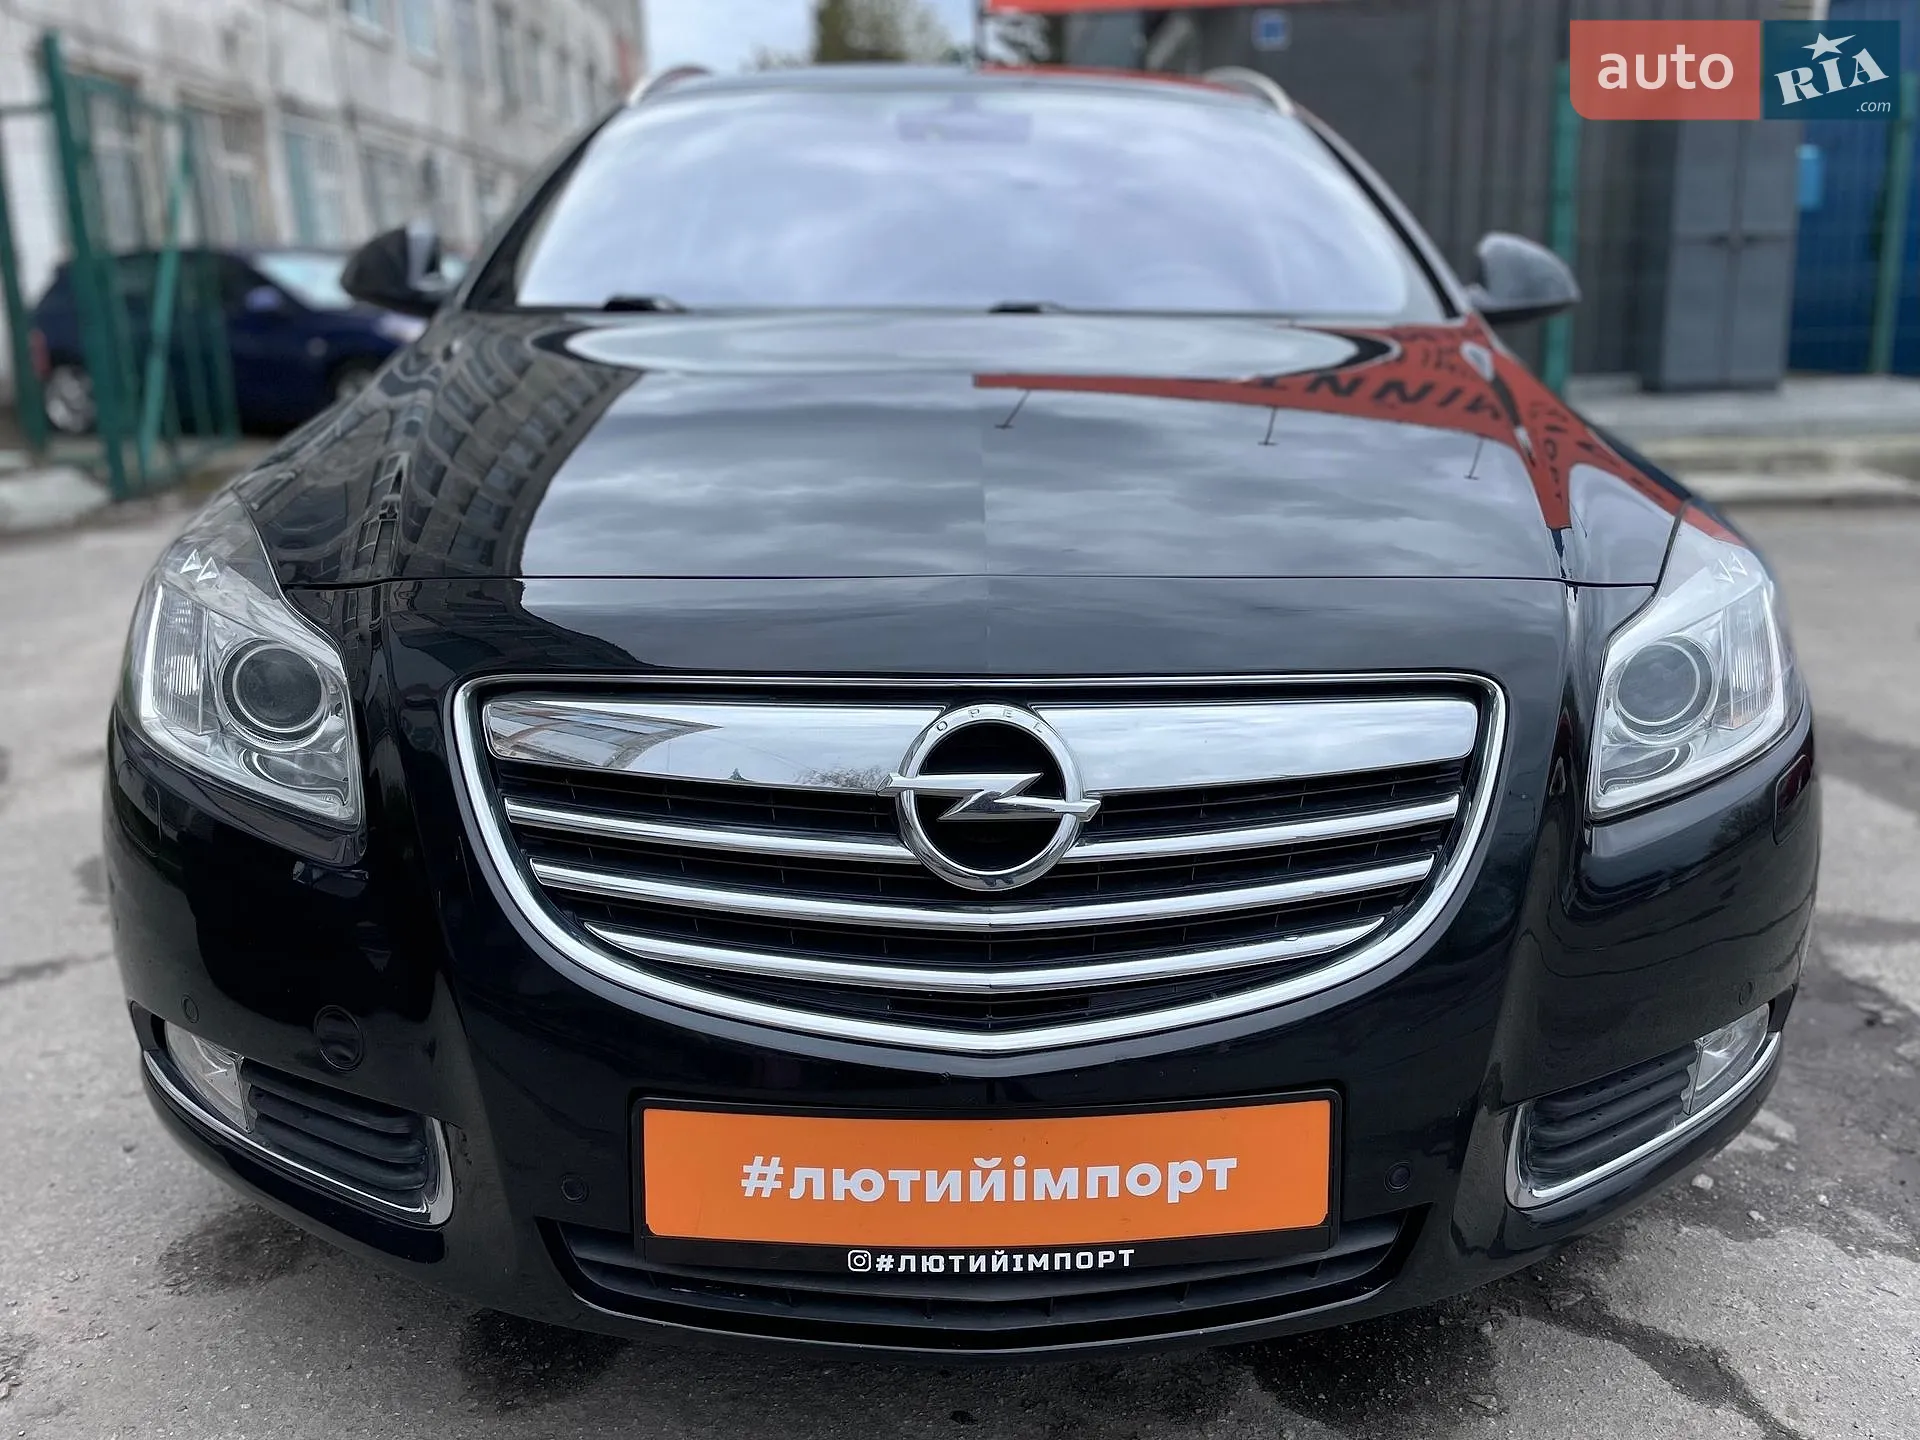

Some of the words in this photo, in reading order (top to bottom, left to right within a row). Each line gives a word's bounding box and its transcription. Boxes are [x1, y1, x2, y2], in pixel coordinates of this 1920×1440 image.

[936, 708, 1044, 734] OPEL
[740, 1154, 1239, 1204] #лютийімпорт
[875, 1249, 1135, 1273] #ЛЮТИЙІМПОРТ
